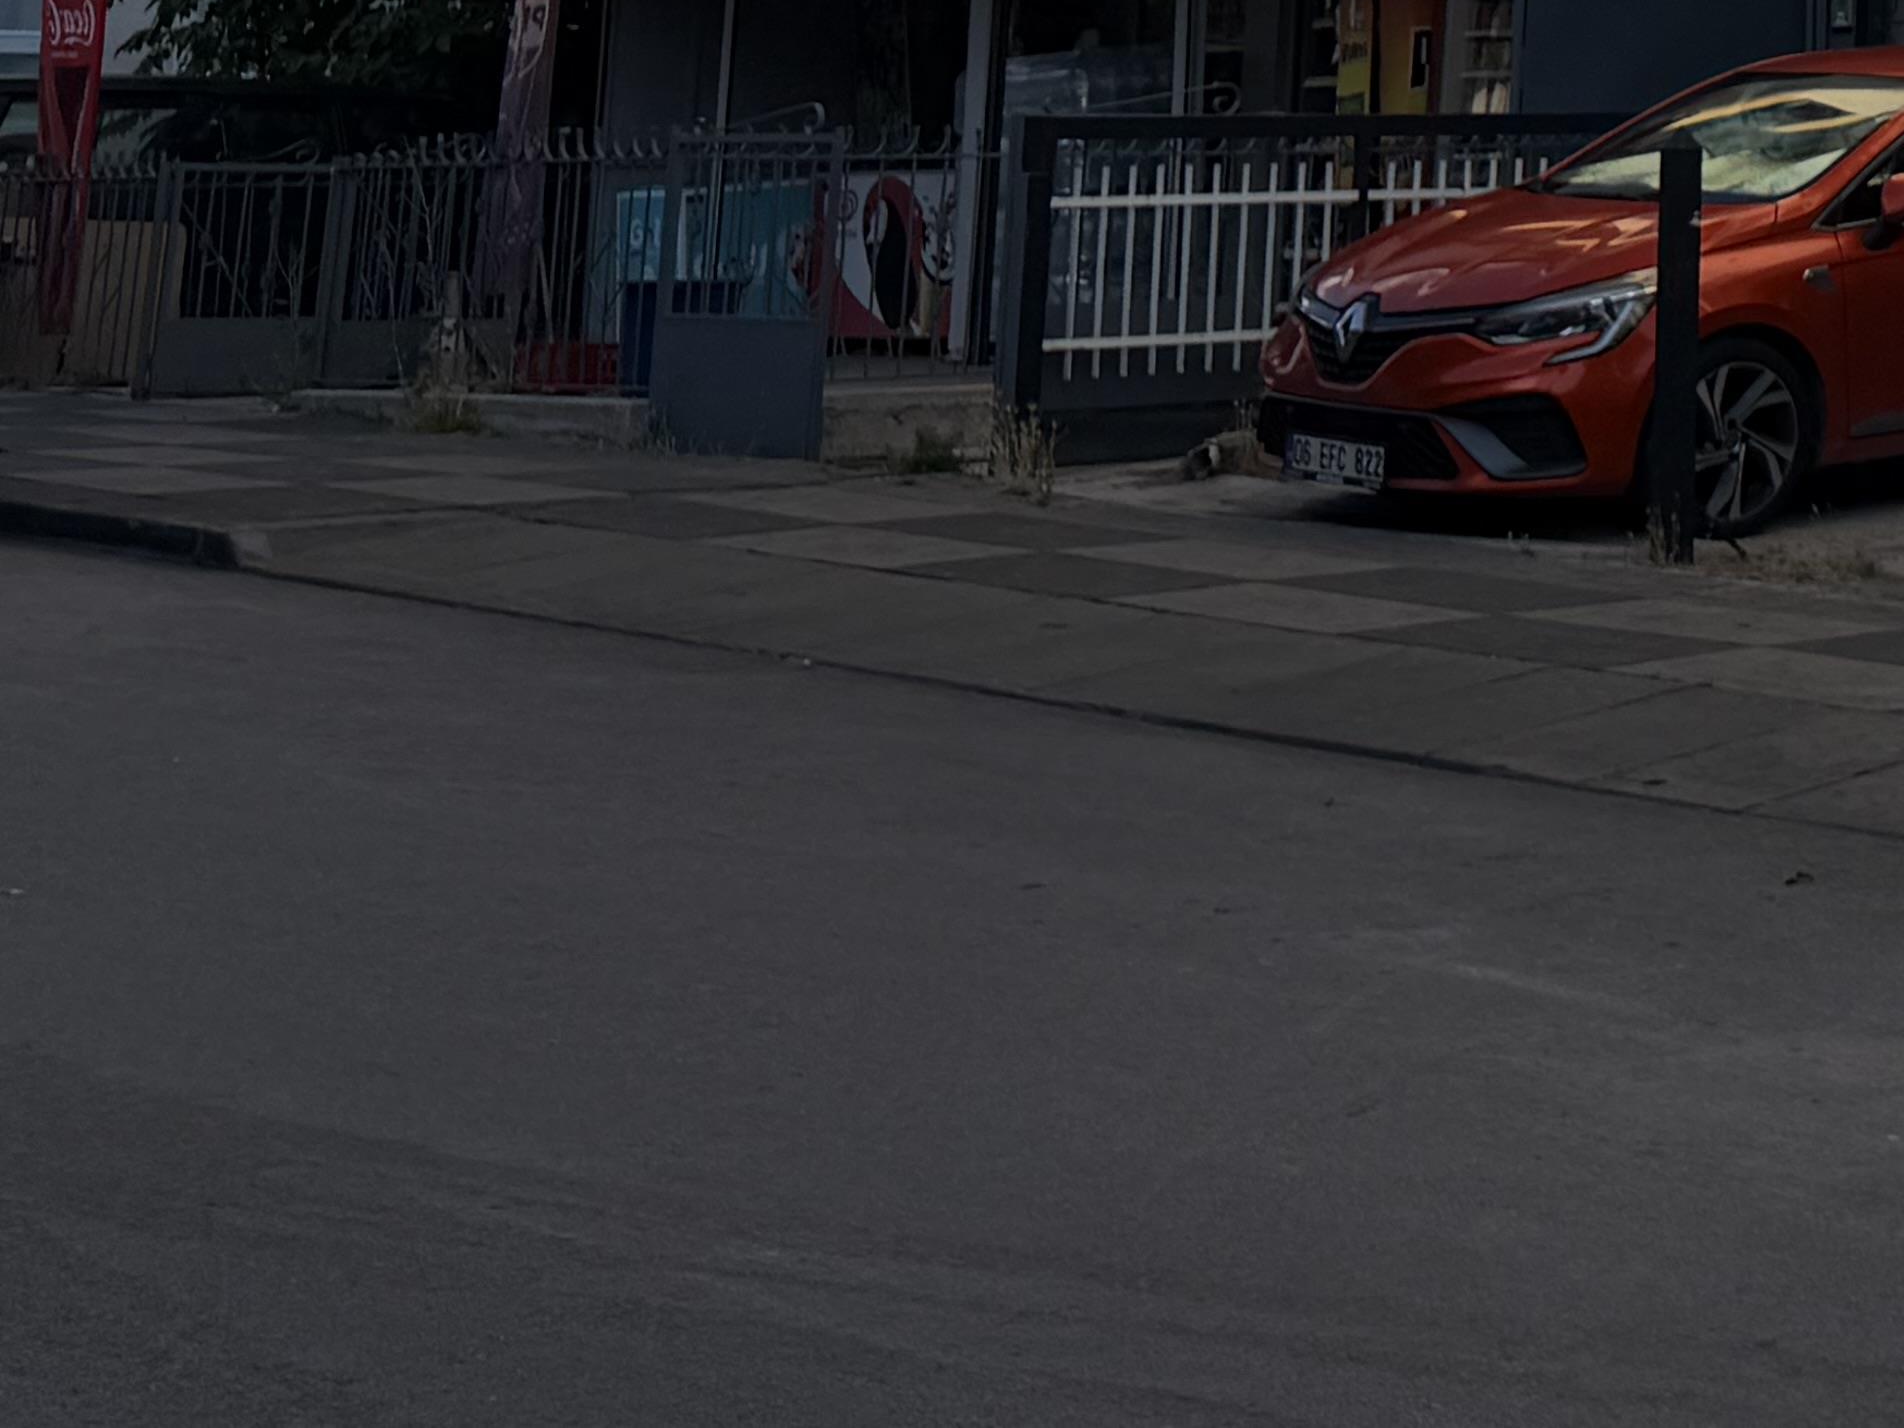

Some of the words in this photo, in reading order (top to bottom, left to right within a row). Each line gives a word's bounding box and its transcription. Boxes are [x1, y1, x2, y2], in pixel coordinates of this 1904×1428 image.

[1294, 438, 1311, 466] 06
[1320, 443, 1346, 470] EFC
[1356, 447, 1382, 477] 822
